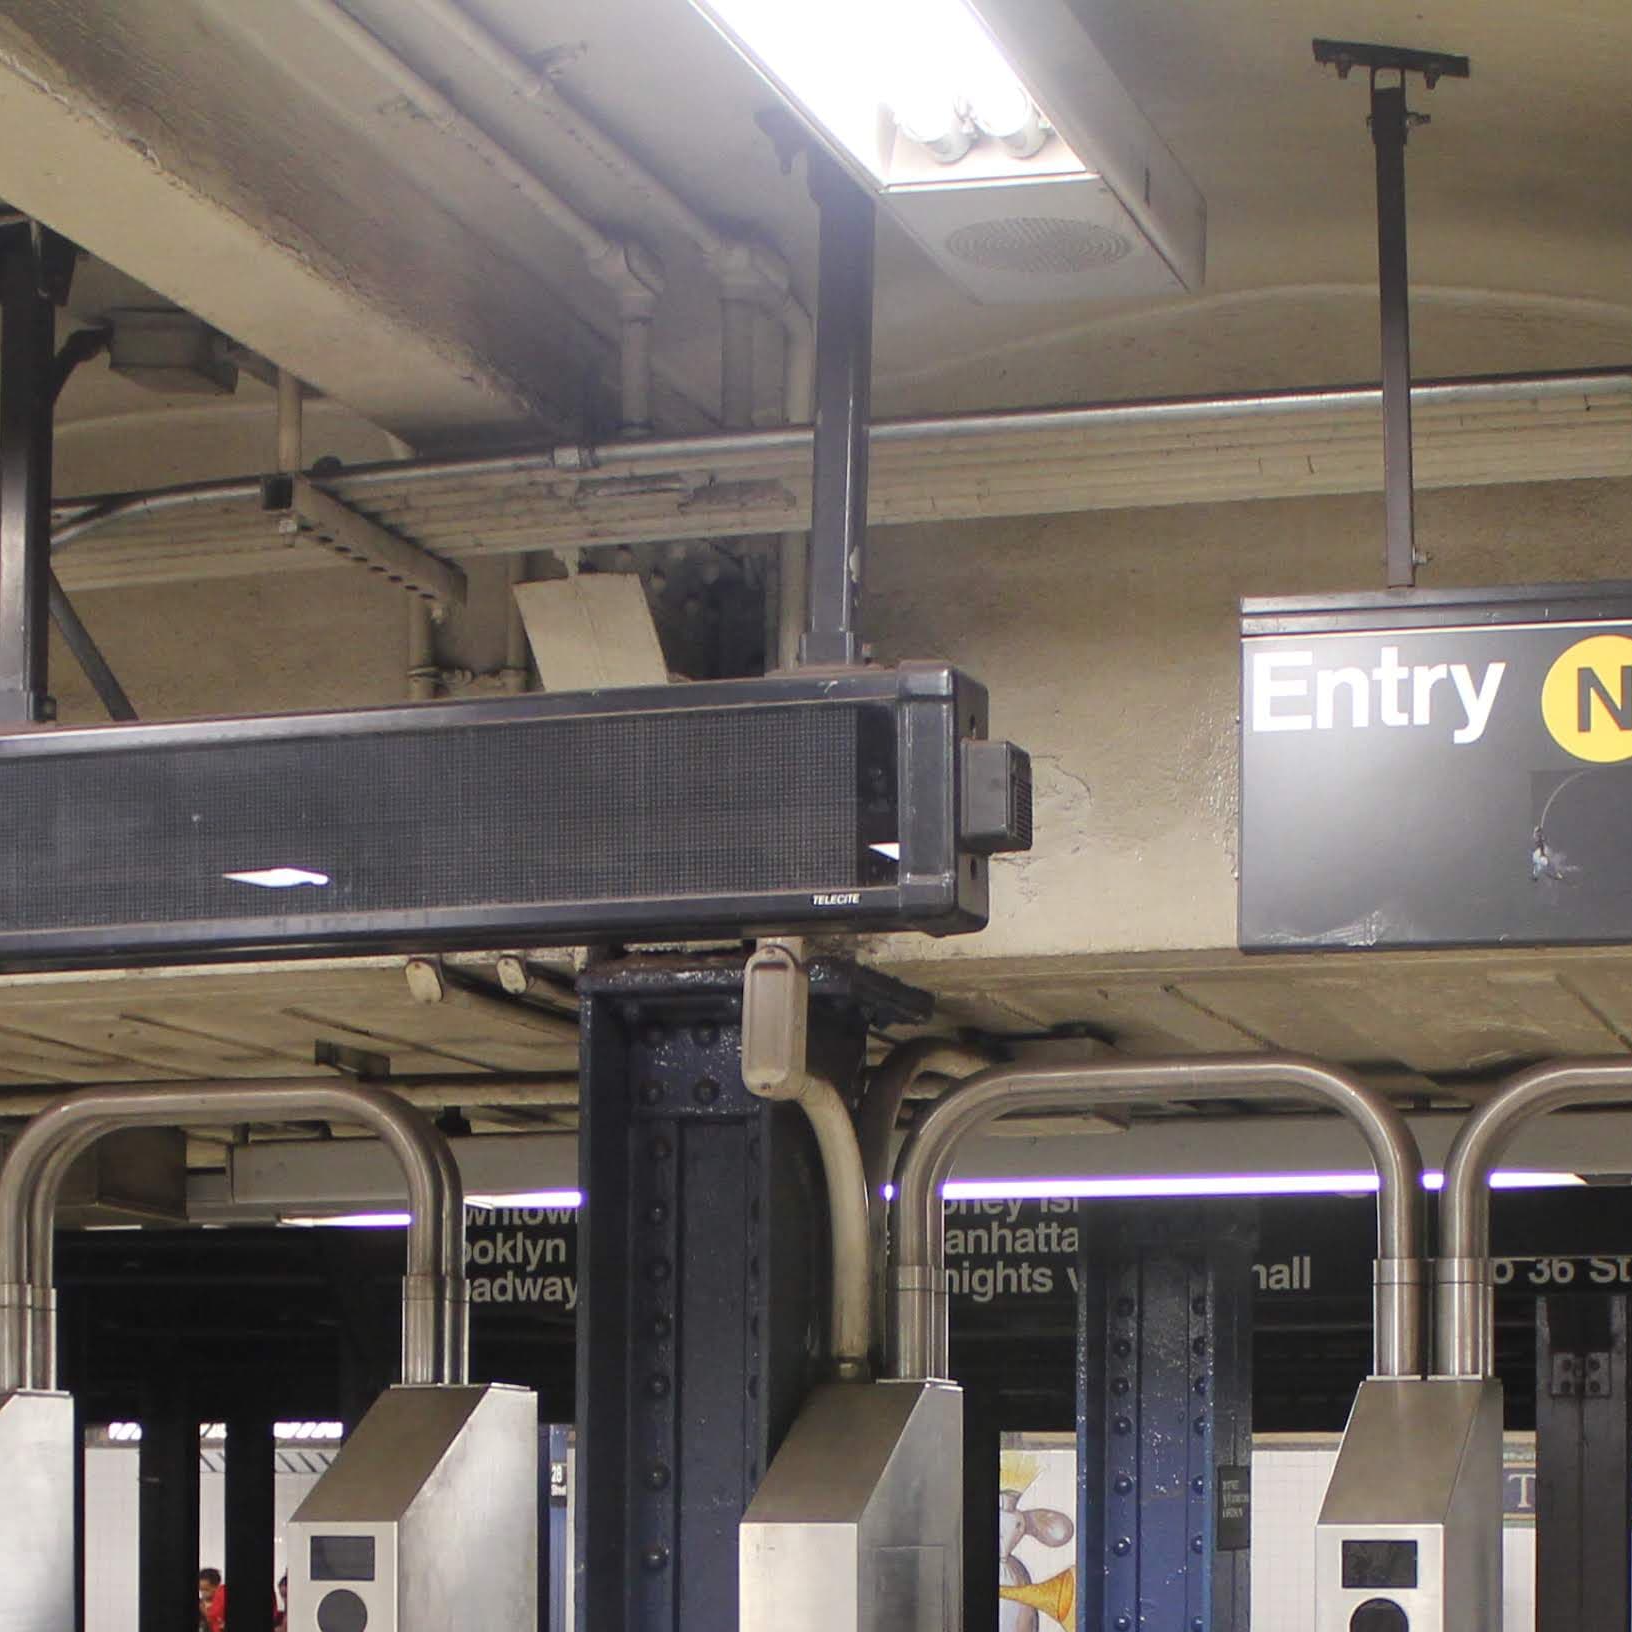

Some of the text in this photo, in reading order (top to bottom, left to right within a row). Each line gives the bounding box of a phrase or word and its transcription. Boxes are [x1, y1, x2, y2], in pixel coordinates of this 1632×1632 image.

[1251, 649, 1506, 745] Entry
[813, 892, 860, 905] TELECITE
[1527, 1256, 1574, 1284] 36
[468, 1269, 578, 1310] adway
